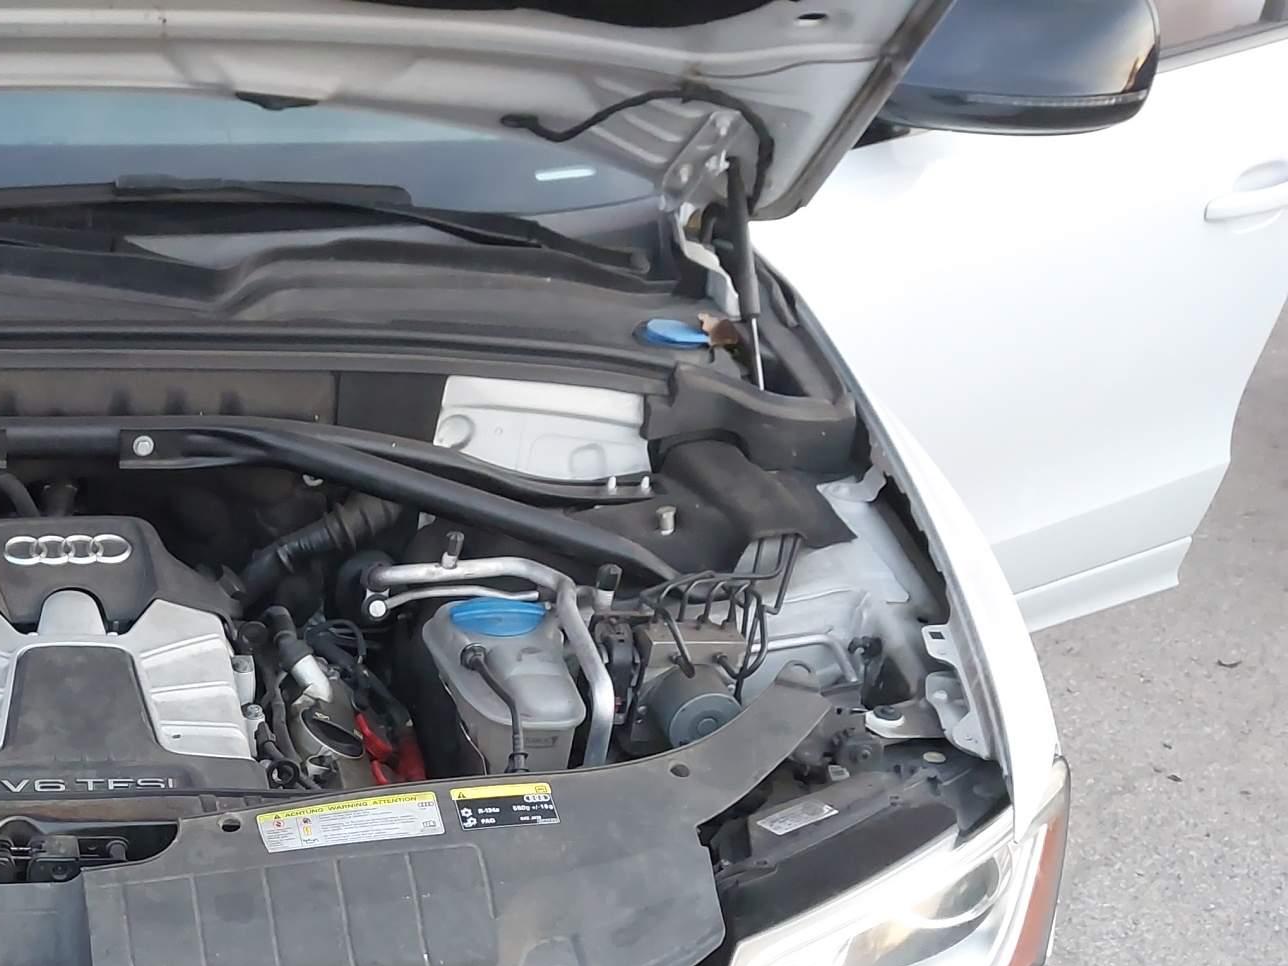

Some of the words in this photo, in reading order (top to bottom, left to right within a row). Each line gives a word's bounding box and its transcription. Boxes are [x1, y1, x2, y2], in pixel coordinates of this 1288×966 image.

[0, 779, 66, 793] V6
[76, 778, 175, 792] TFSI
[284, 808, 324, 818] ACHTUNG
[328, 802, 368, 811] WARNING
[372, 796, 417, 805] ATTENTION
